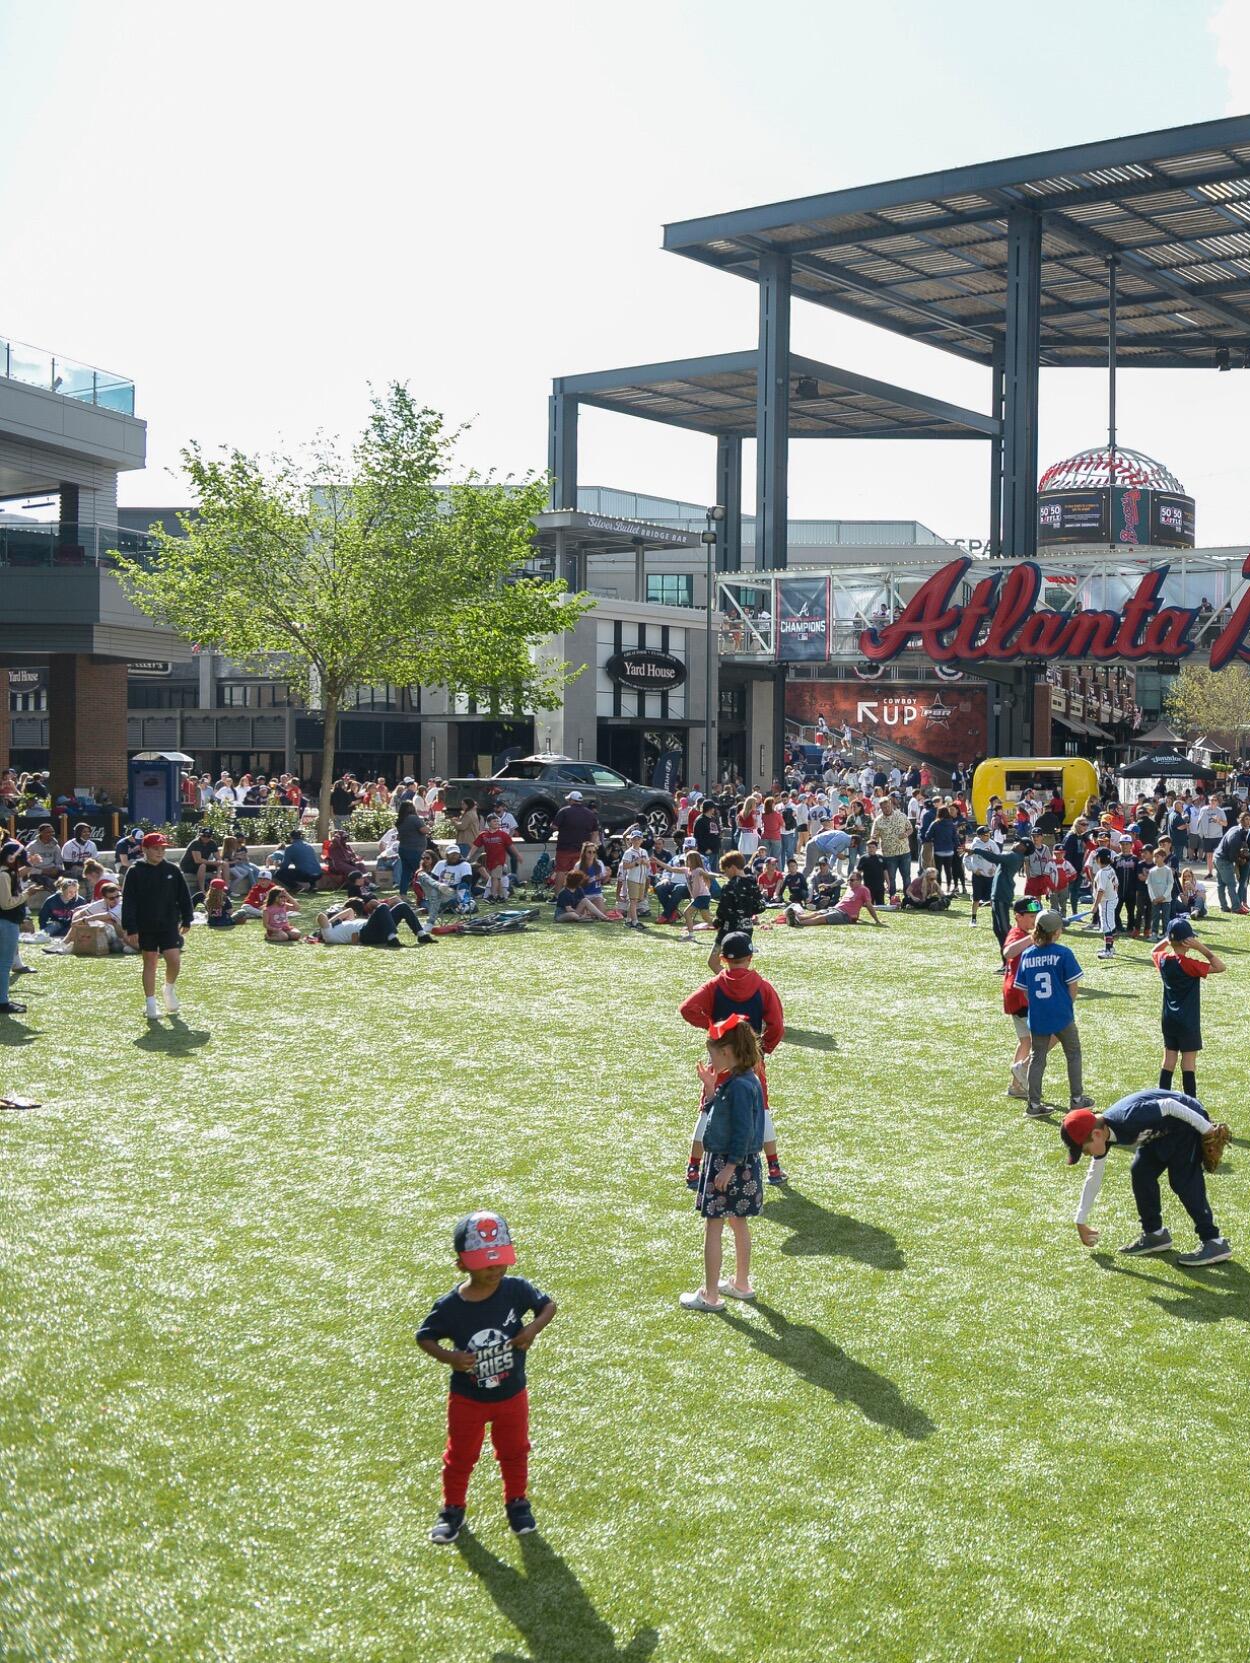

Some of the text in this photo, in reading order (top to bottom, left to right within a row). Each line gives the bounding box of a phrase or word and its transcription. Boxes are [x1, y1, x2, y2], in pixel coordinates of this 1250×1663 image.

[858, 556, 1201, 662] Atlanta
[780, 620, 826, 633] CHAMPIONS
[9, 670, 39, 682] Yard House
[624, 661, 676, 678] Yard House
[883, 706, 917, 725] UP
[1022, 954, 1061, 970] MURPHY
[1035, 972, 1052, 999] 3
